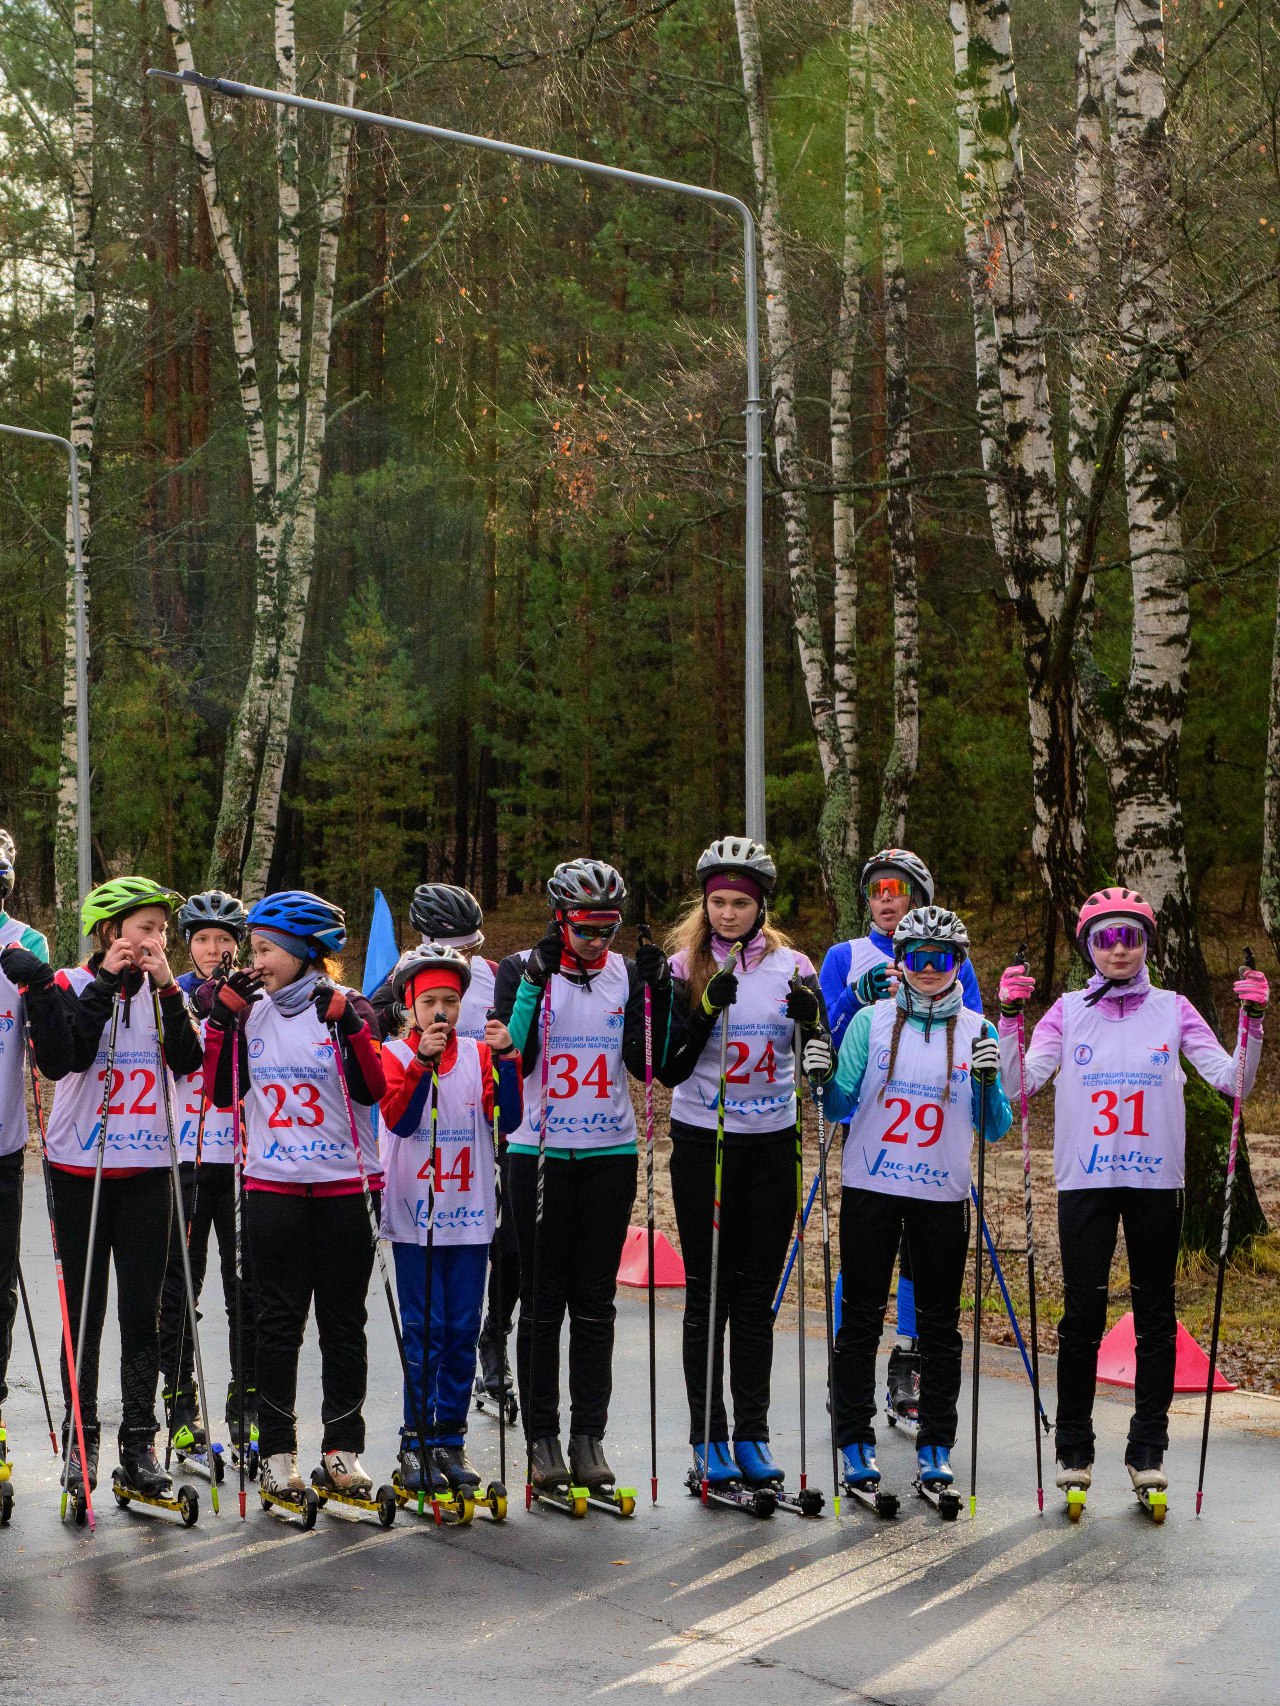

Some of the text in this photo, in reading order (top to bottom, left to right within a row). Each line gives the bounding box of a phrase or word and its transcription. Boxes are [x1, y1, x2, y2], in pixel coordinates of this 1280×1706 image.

[290, 1066, 328, 1074] БИАТЛОНА
[549, 1053, 614, 1099] 34
[721, 1041, 777, 1085] 24
[1082, 1071, 1163, 1080] ФЕДЕРАЦИЯ БИАТЛОНА
[1082, 1079, 1126, 1087] РЕСПУБЛИКИ
[96, 1068, 157, 1115] 22
[186, 1072, 235, 1114] 3
[262, 1083, 325, 1129] 23
[1090, 1090, 1150, 1137] 31
[881, 1097, 945, 1148] 29
[416, 1146, 474, 1193] 44
